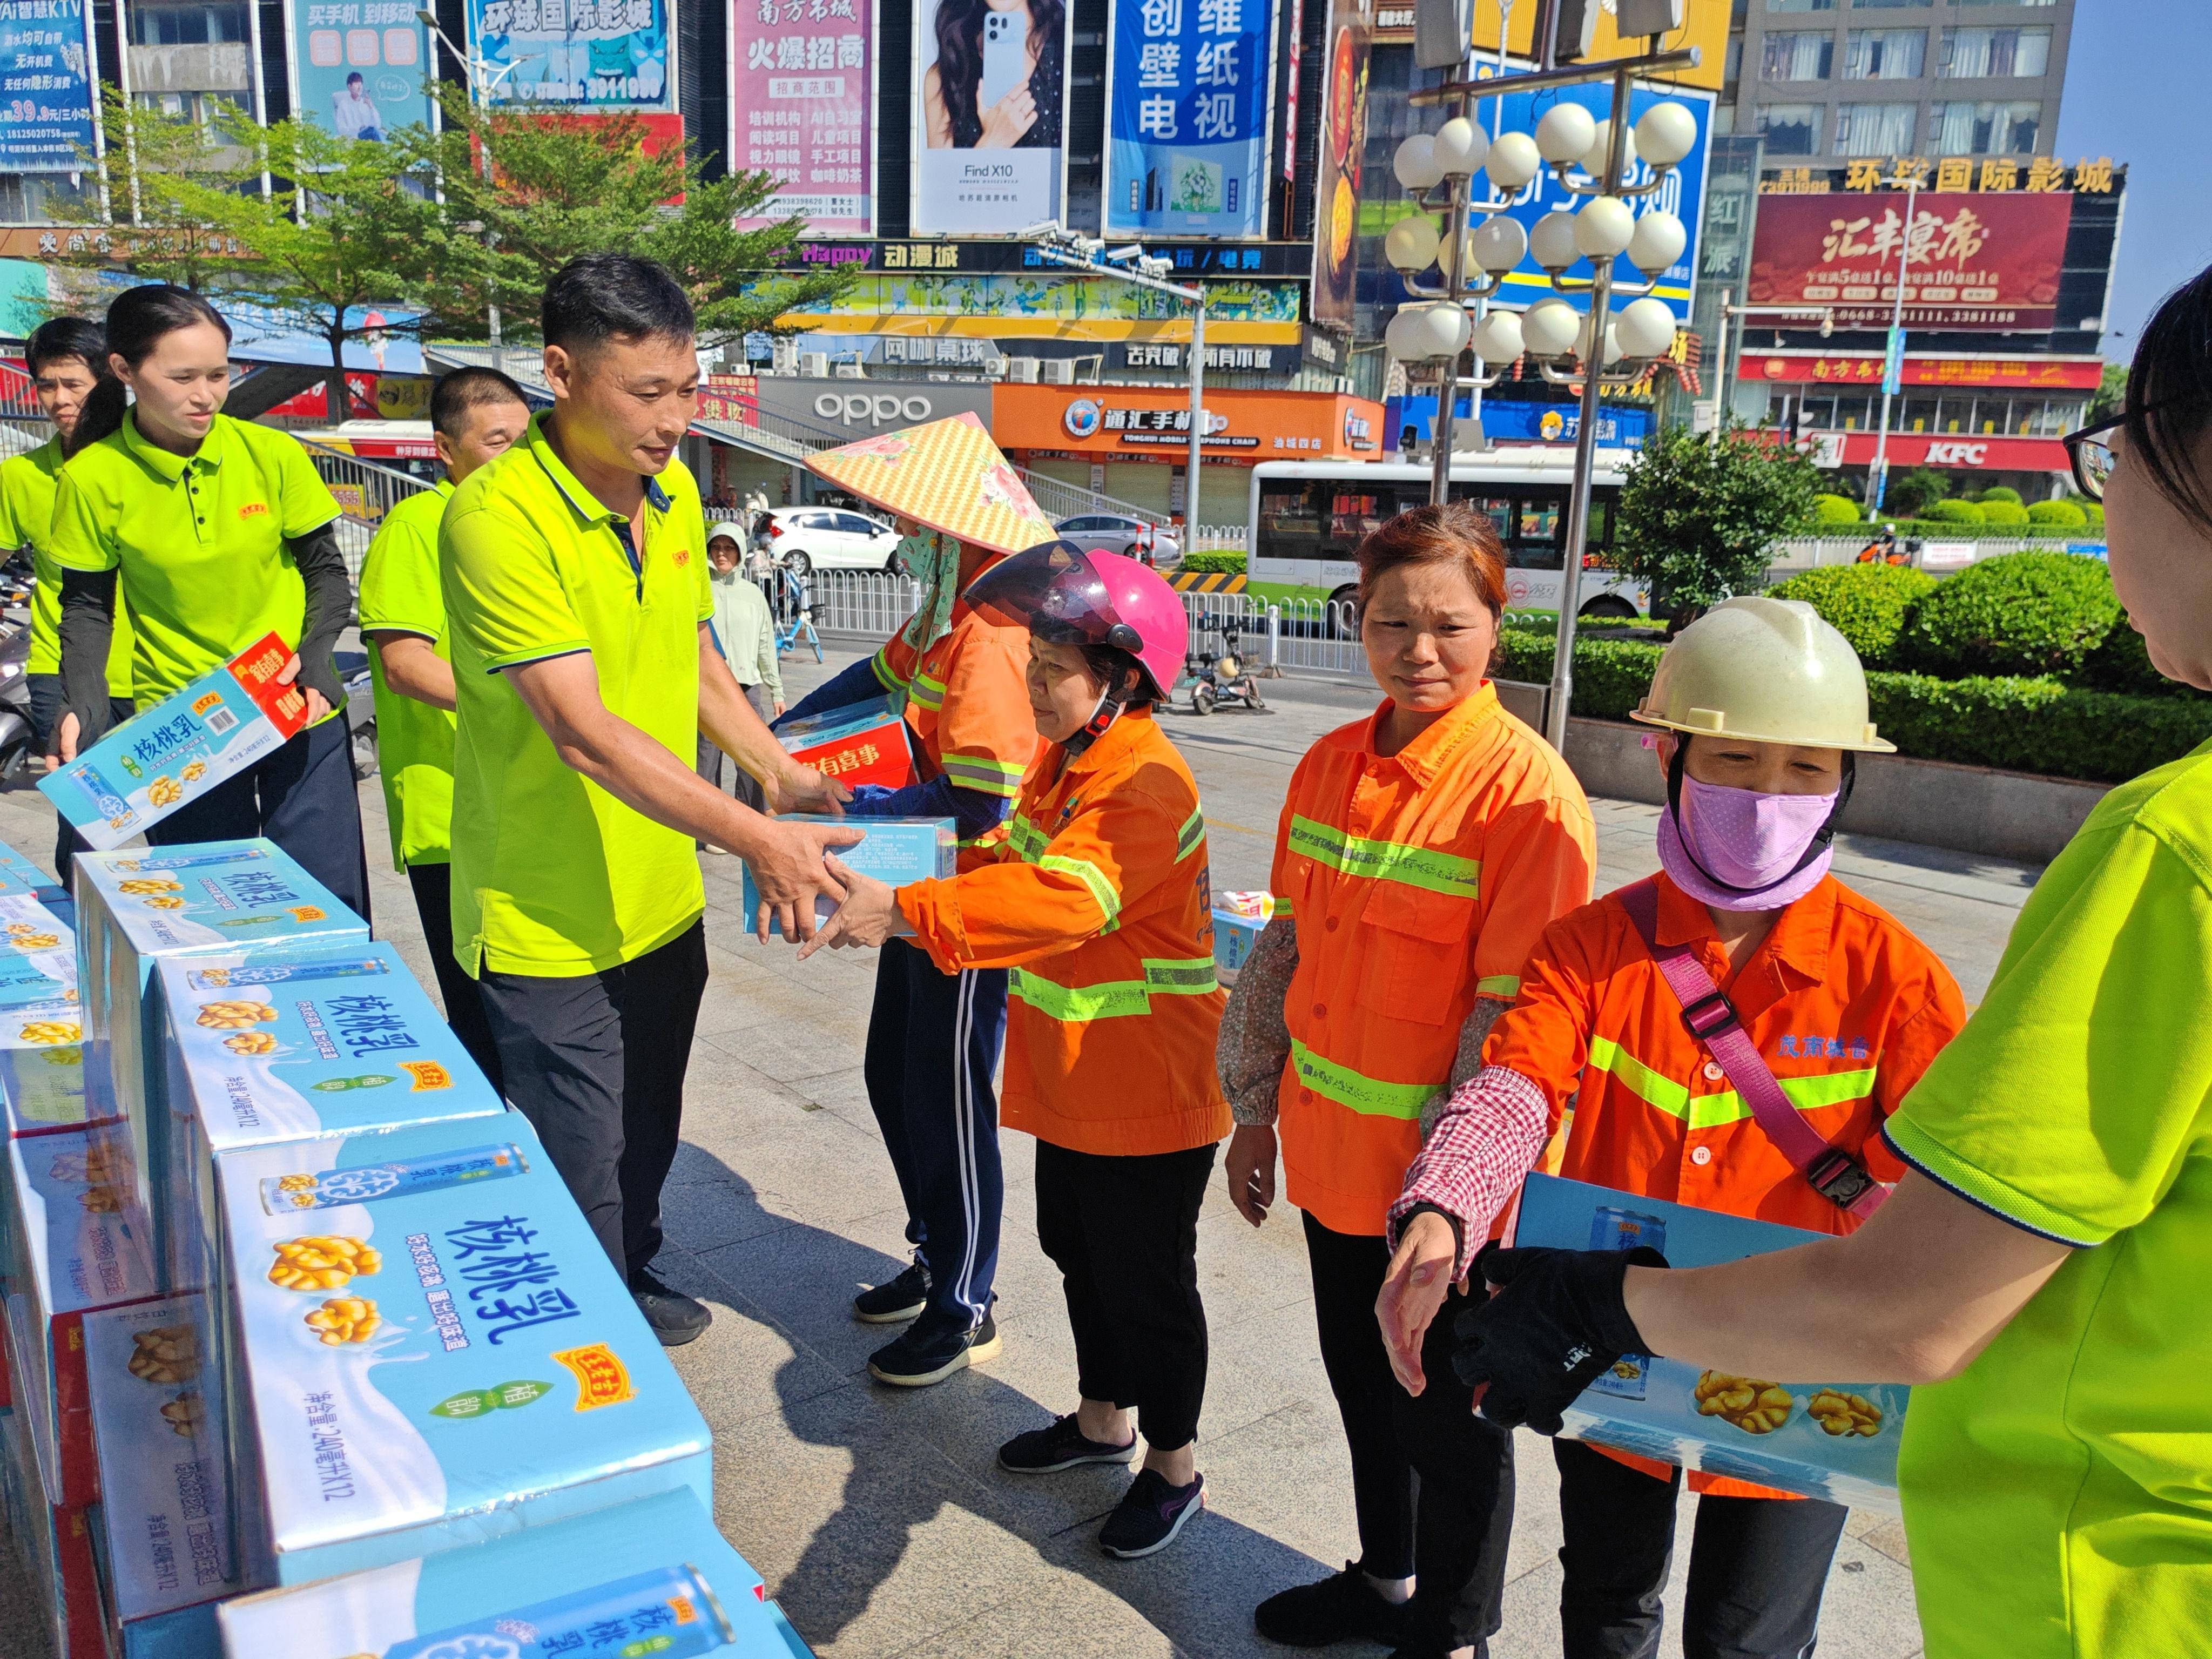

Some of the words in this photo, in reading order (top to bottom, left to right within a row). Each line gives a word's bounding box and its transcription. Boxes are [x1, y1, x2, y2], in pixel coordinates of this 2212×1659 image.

[308, 4, 359, 25] 买手机
[364, 2, 416, 24] 到移动
[485, 0, 651, 32] 环球国际影城
[15, 53, 53, 69] 无开机费
[748, 35, 865, 70] 火爆招商
[777, 81, 836, 95] 招商范围
[749, 110, 801, 126] 培训机构
[812, 110, 862, 125] AI自习室
[7, 129, 60, 139] 18125020758
[749, 130, 800, 145] 阅读项目
[812, 130, 861, 145] 儿童项目
[749, 149, 801, 164] 视力眼镜
[812, 149, 861, 164] 手工项目
[811, 168, 862, 183] 咖啡奶茶
[965, 165, 989, 177] Find
[992, 165, 1013, 177] X10
[1845, 156, 2113, 194] 环球国际影城
[1822, 208, 1983, 270] 汇丰宴席
[885, 245, 958, 267] 动漫城
[885, 337, 984, 363] 网咖桌球
[1128, 346, 1179, 366] 去突破
[1186, 348, 1272, 369] 所有不破
[814, 393, 932, 427] oppo
[1124, 434, 1157, 443] TONGHUI
[1232, 438, 1257, 446] CHAIN
[1925, 442, 1987, 465] KFC
[133, 713, 203, 762] 核桃乳
[221, 871, 301, 908] 核桃乳
[325, 994, 420, 1058] 核桃乳
[1778, 1034, 1870, 1060] 茂南城管
[411, 1158, 494, 1183] 核桃乳
[406, 1232, 446, 1288] 好水好核桃
[426, 1289, 471, 1352] 磨出好味道
[445, 1215, 582, 1345] 核桃乳
[542, 1606, 673, 1658] 核桃乳
